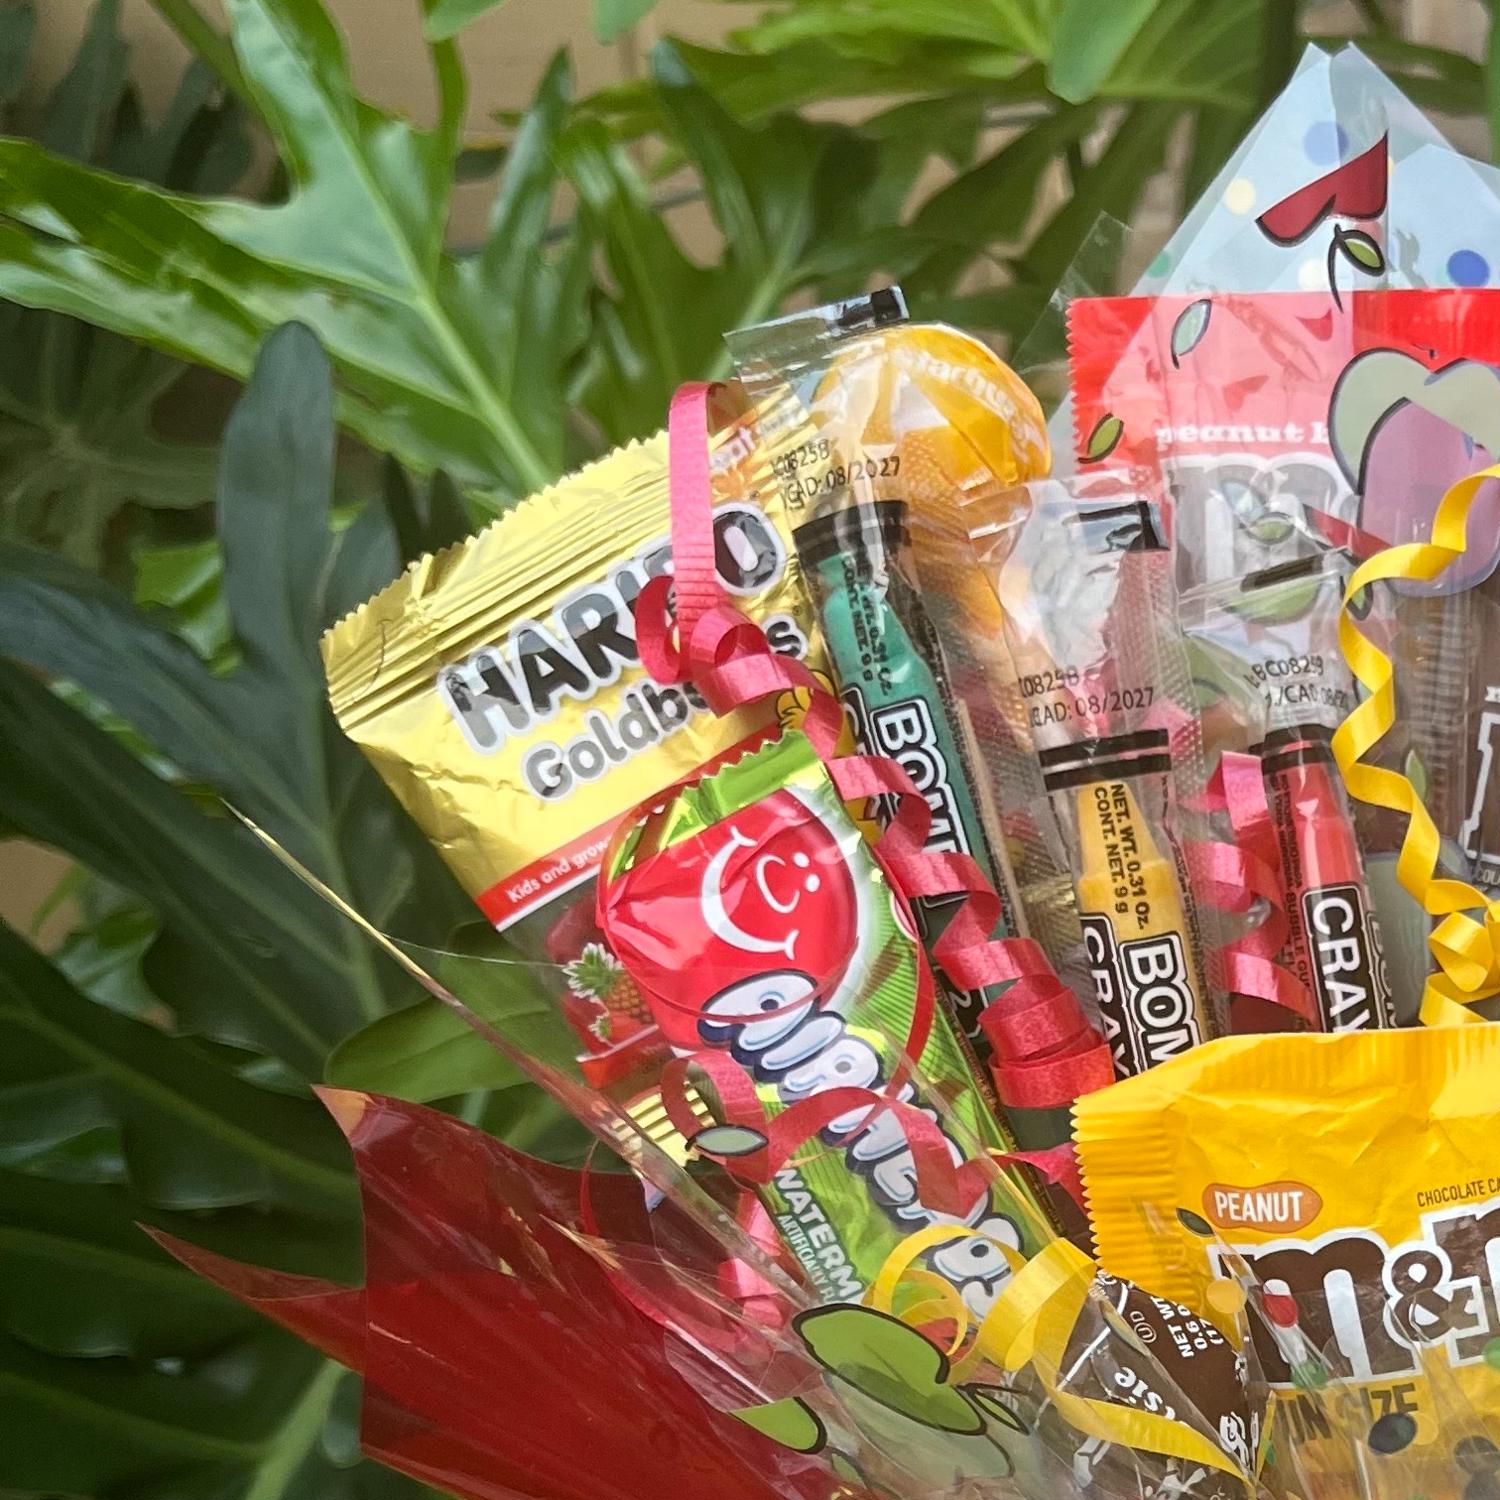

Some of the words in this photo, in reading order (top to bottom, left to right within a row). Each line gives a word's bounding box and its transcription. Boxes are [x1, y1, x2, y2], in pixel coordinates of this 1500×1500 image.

[441, 504, 784, 754] HARIO
[523, 614, 806, 800] Goldbs
[1076, 686, 1155, 717] 08/2027
[1092, 785, 1117, 840] CONT.
[1109, 782, 1131, 822] NET.
[1118, 825, 1139, 858] WT.
[1104, 842, 1127, 883] NET.
[1125, 859, 1147, 898] 0.31
[505, 878, 541, 905] Kids
[542, 860, 571, 887] and
[1113, 885, 1129, 897] 9
[1113, 900, 1130, 914] g
[1284, 891, 1306, 955] BUBBLE
[1083, 924, 1131, 1078] CRAY
[1213, 1187, 1304, 1225] PEANUT
[1417, 1178, 1486, 1208] CHOCOLATE
[1149, 1295, 1175, 1326] WT
[1167, 1324, 1195, 1358] NET
[1186, 1322, 1208, 1351] 0.6
